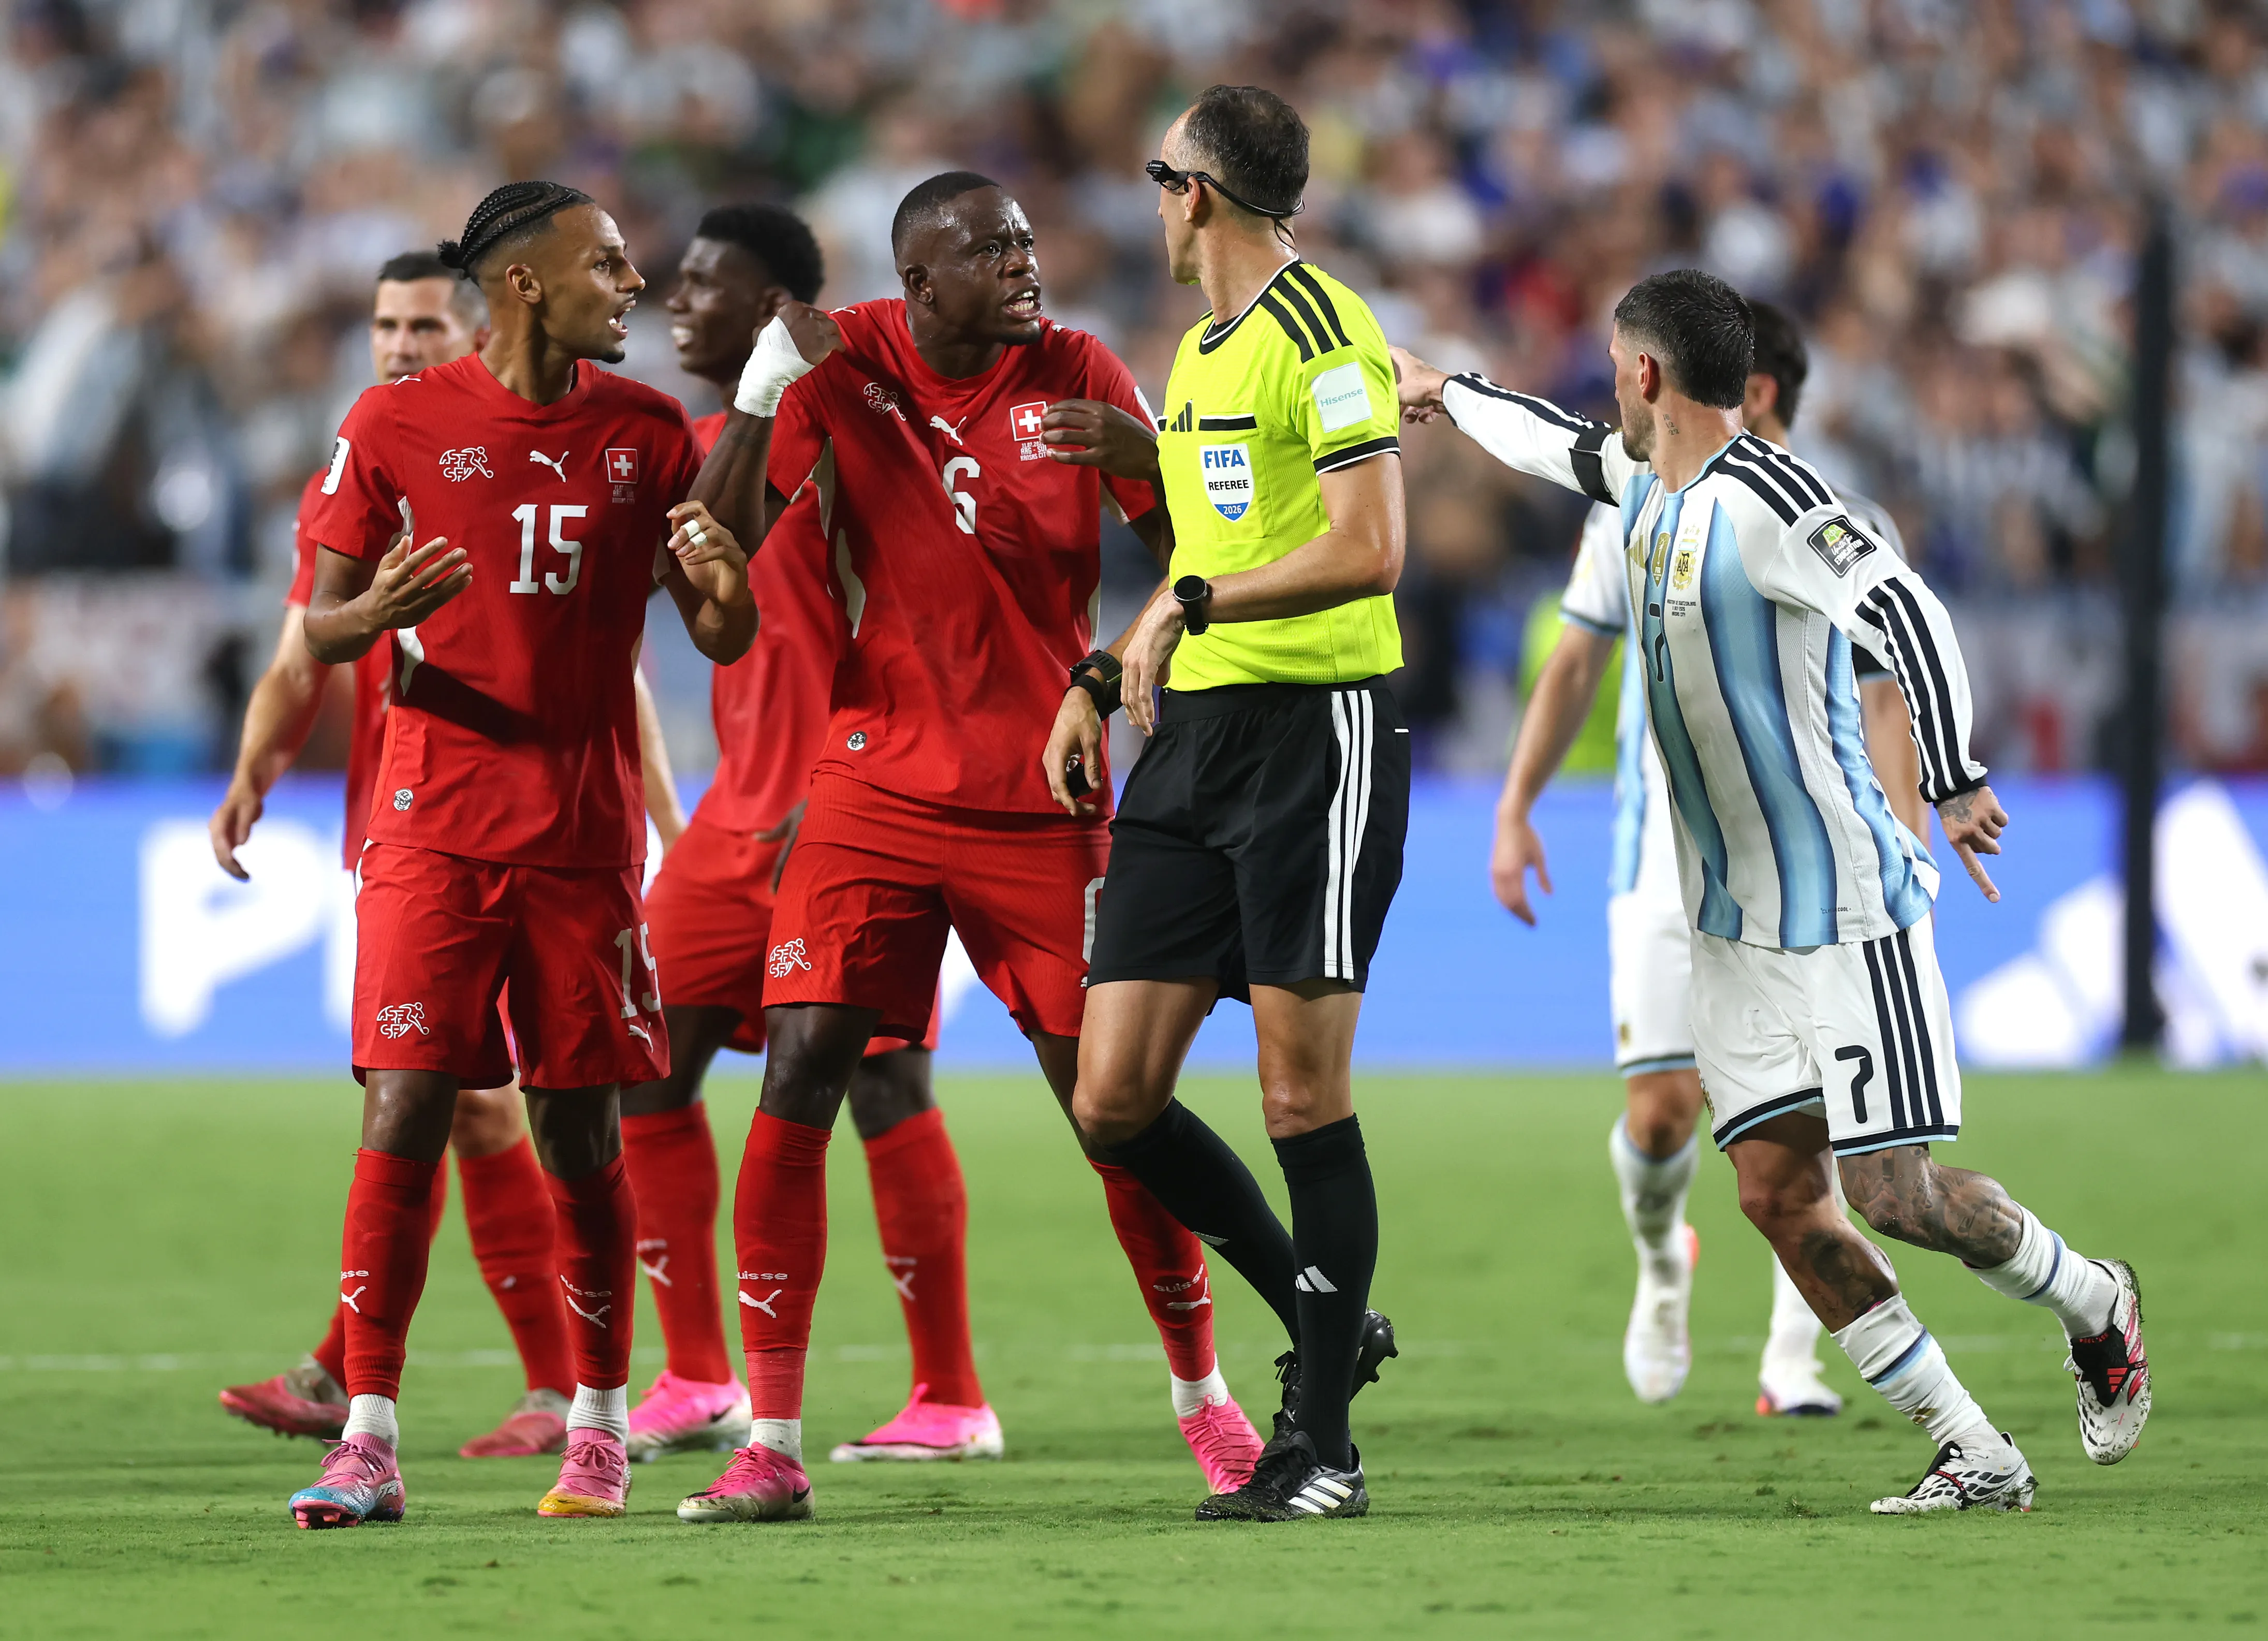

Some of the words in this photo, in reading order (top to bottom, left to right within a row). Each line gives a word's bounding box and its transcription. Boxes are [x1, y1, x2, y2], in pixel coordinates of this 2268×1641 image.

[1320, 388, 1363, 407] Hisense
[1020, 453, 1038, 461] KANSAS
[1037, 445, 1047, 453] SUI
[1204, 449, 1246, 468] FIFA
[1208, 479, 1249, 491] REFEREE
[942, 457, 981, 535] 6
[1223, 505, 1242, 515] 2026
[509, 503, 589, 595] 15
[1834, 538, 1865, 566] EDUCATION
[1846, 551, 1859, 562] FIFA
[1677, 552, 1690, 576] AFA
[613, 921, 661, 1019] 15
[1835, 1045, 1874, 1124] 7
[736, 1270, 788, 1280] uisse
